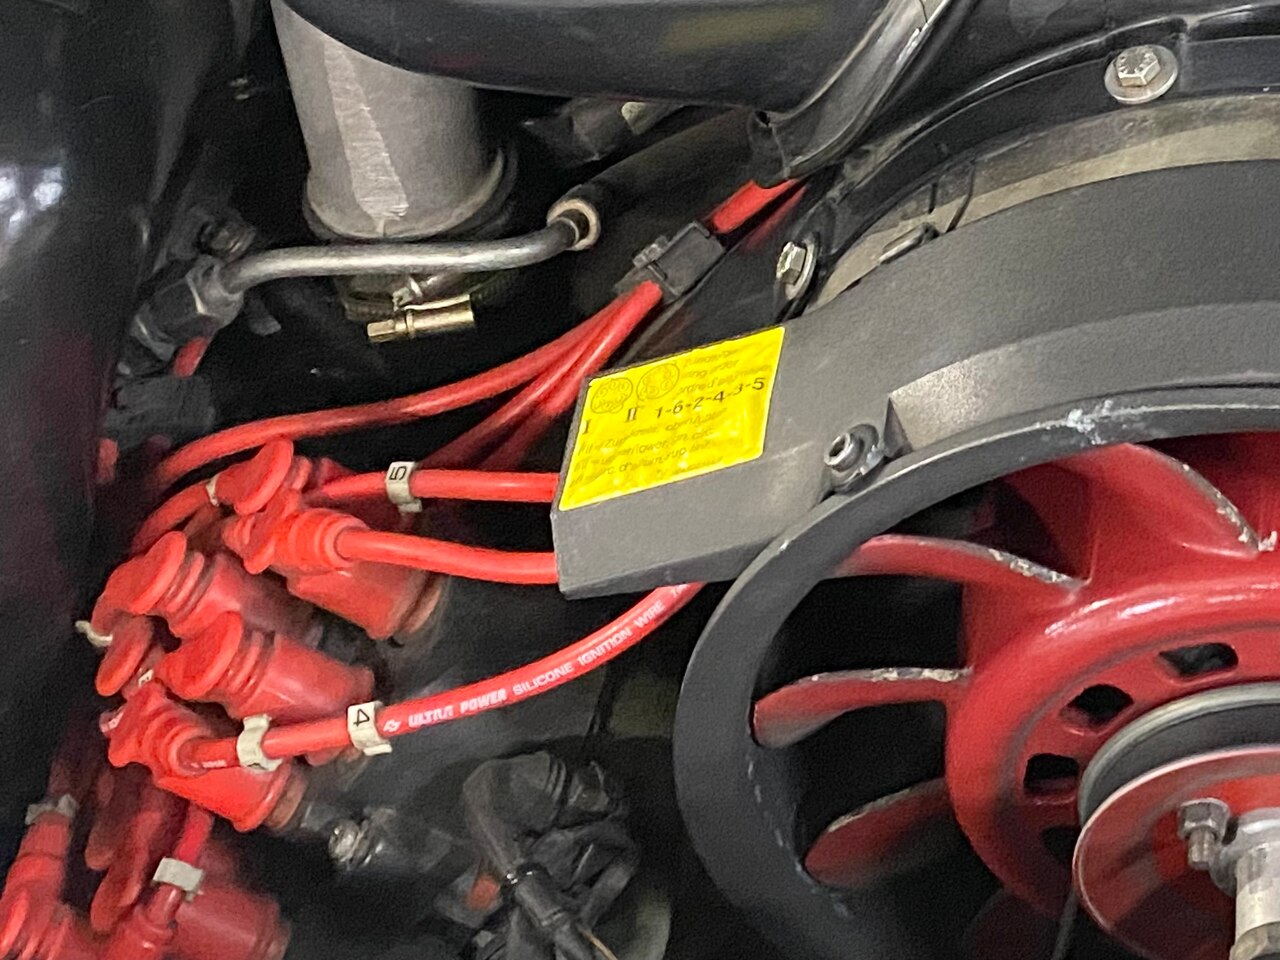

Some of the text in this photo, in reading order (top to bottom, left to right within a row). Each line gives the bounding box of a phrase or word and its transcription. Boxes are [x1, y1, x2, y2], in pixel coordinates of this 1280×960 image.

[388, 465, 407, 481] 5
[408, 600, 667, 729] ULTRA POWER SILICONE IGNITION WIRE
[353, 708, 370, 727] 4
